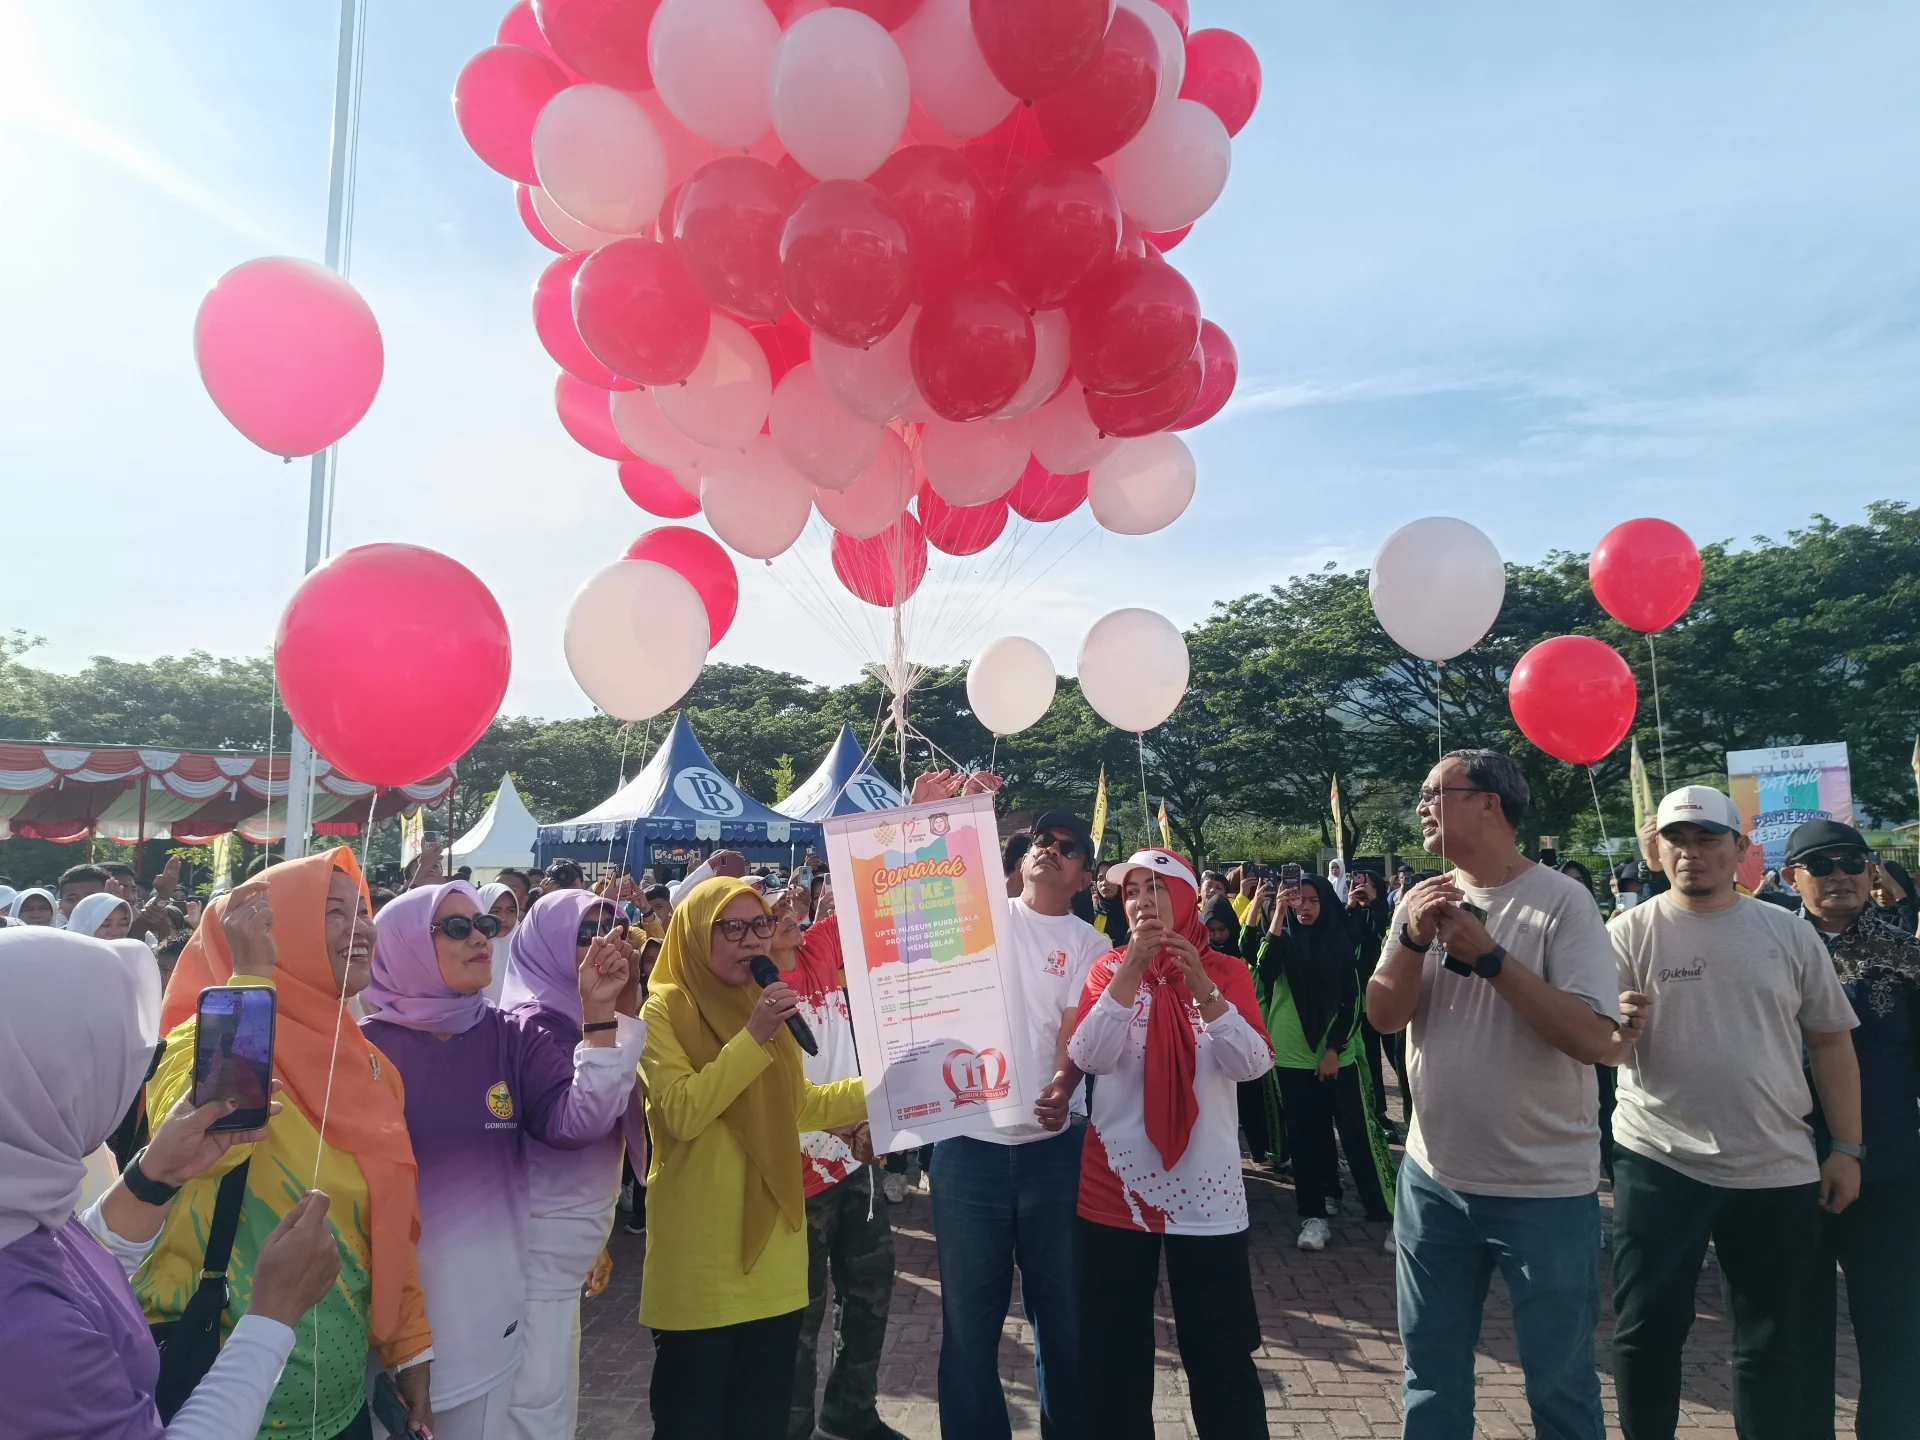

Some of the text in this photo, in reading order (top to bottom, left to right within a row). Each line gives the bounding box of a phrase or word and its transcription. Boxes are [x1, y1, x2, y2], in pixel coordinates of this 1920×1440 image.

[1754, 769, 1822, 793] DATANG
[1784, 796, 1795, 804] DI
[872, 855, 966, 894] Semarak
[877, 877, 967, 907] HUT KE-11
[874, 893, 974, 918] MUSEUM GORONTALO
[875, 914, 979, 938] UPTD MUSEUM PURBAKALA
[885, 925, 972, 946] PROVINSI GORONTALO
[907, 938, 954, 952] MENGGELAR
[1658, 966, 1703, 982] Dikbud
